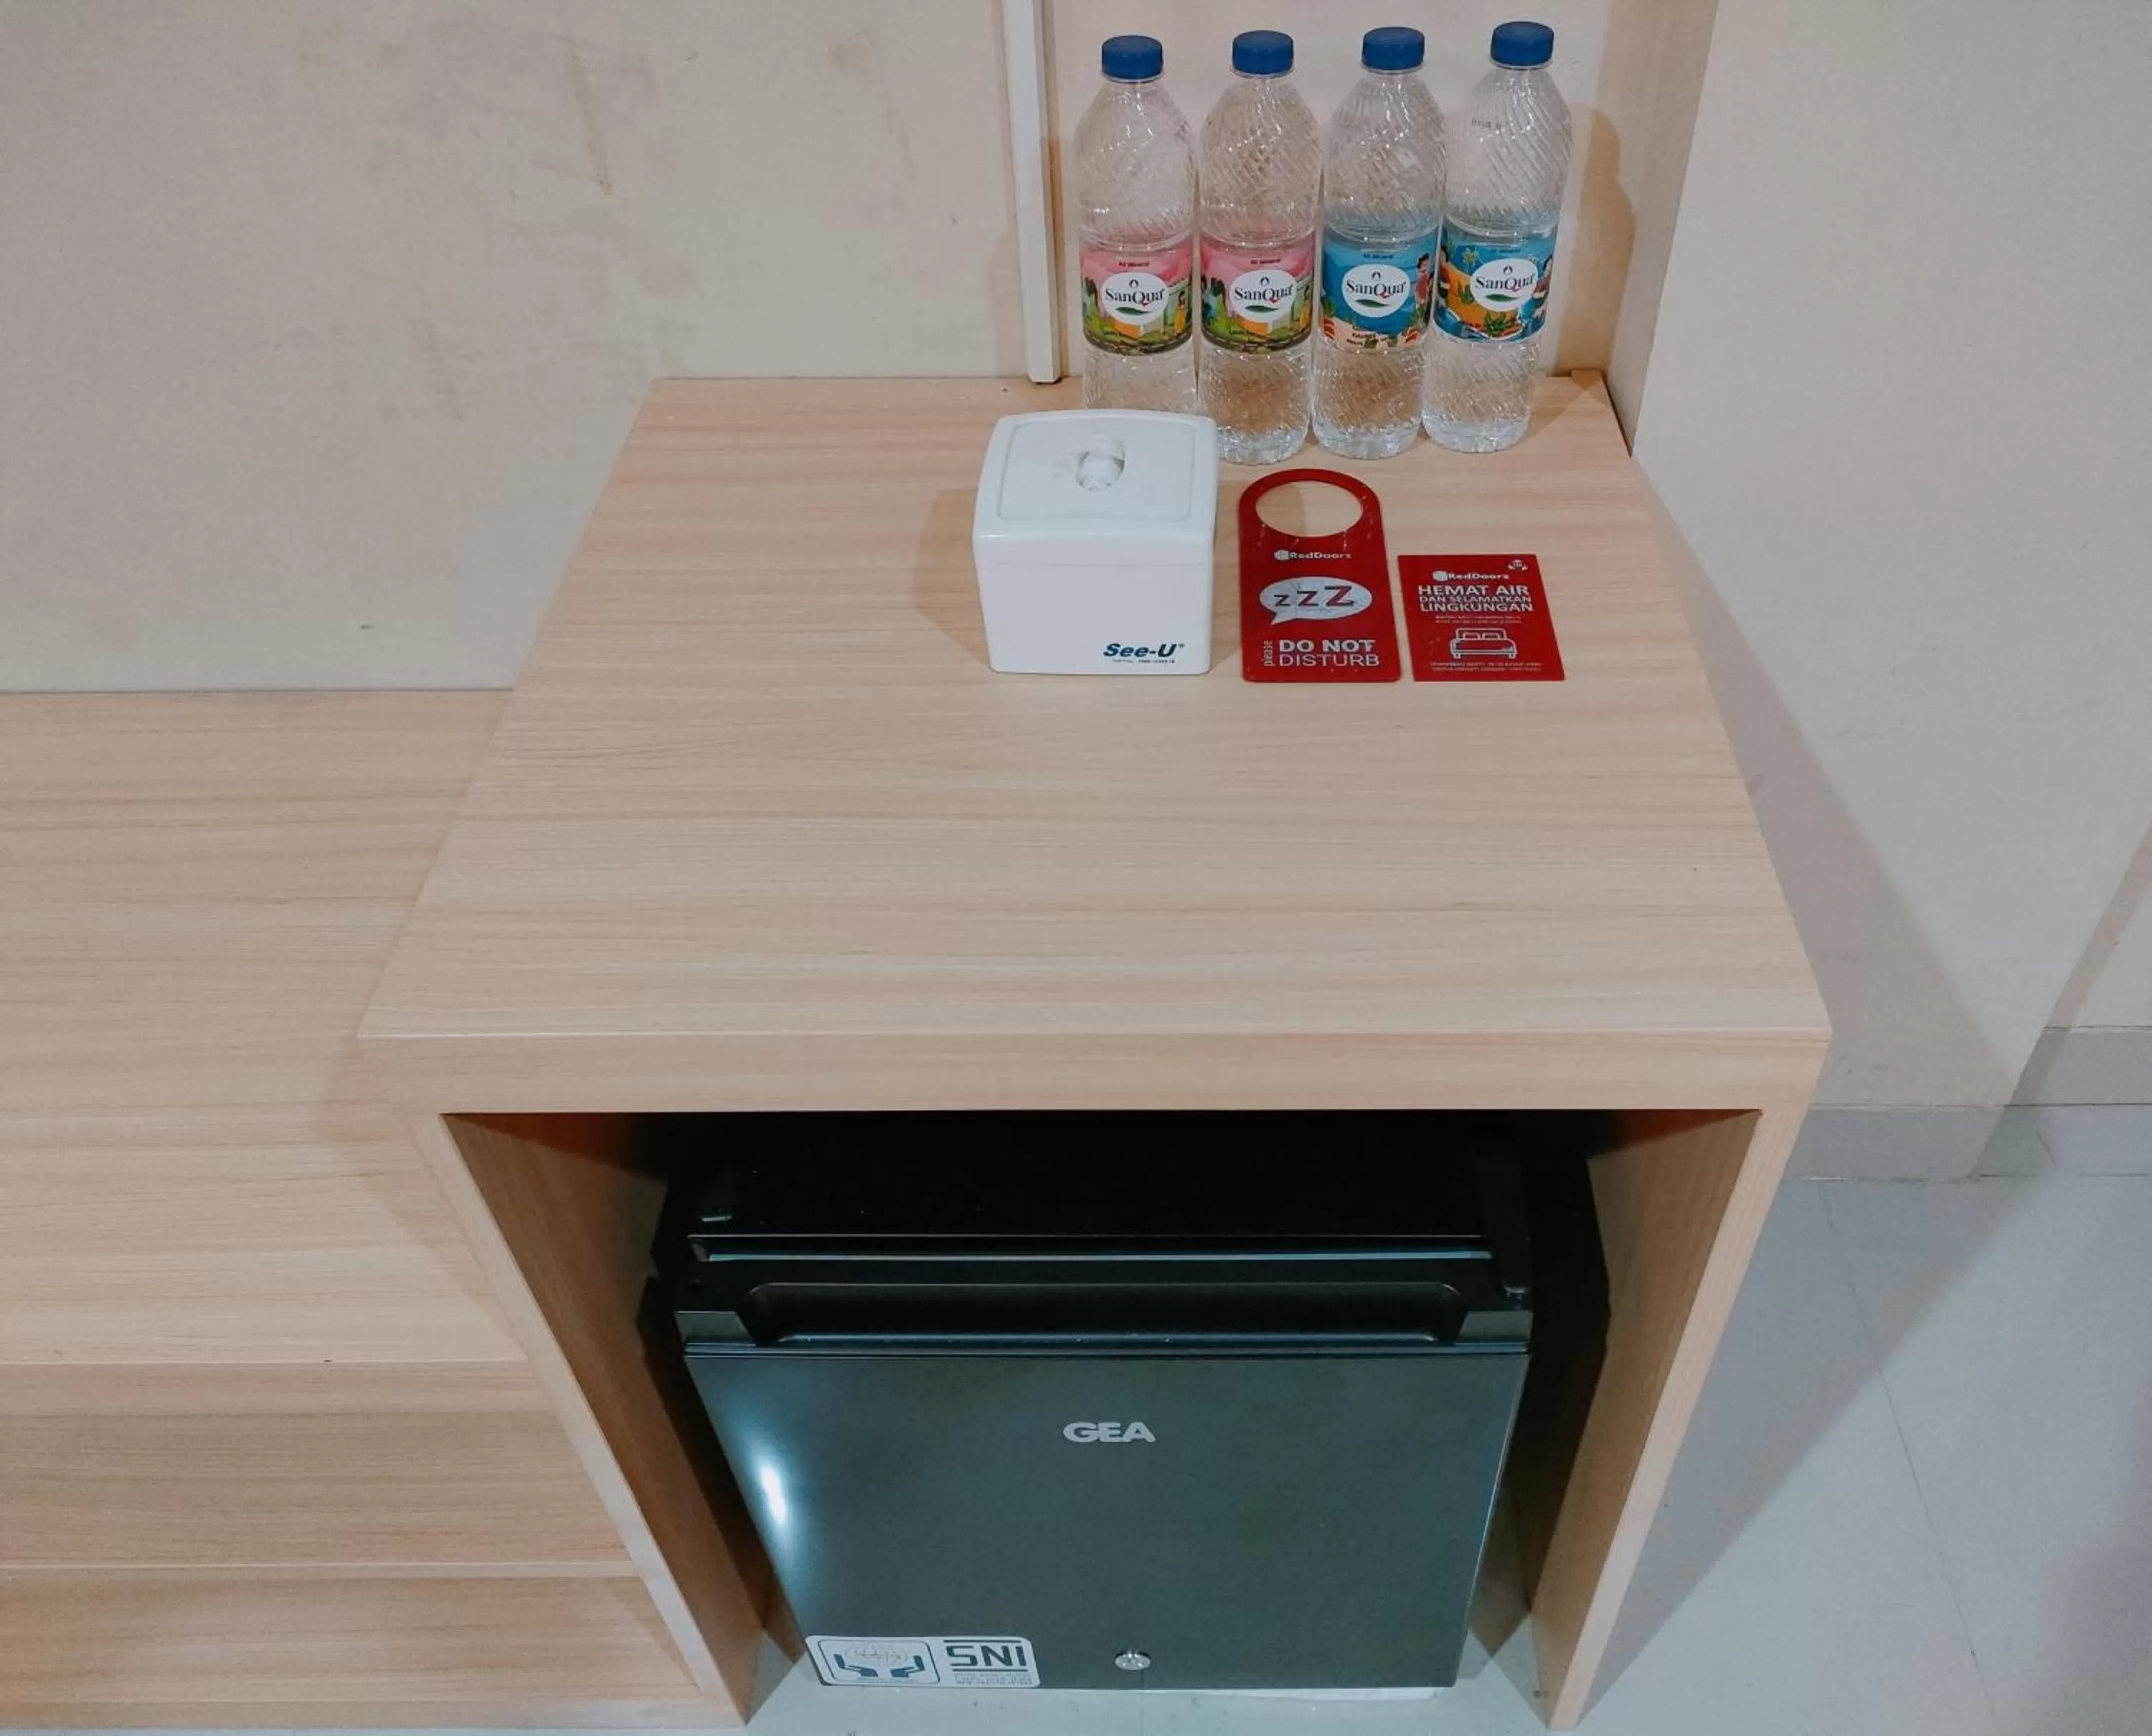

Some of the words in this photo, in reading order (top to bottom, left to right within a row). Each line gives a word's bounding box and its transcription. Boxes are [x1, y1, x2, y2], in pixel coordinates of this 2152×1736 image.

[1346, 280, 1405, 298] SanQua
[1475, 275, 1534, 292] SanQua
[1105, 288, 1164, 306] SanQua
[1235, 285, 1293, 303] SanQua
[1418, 585, 1488, 595] HEMAT
[1496, 585, 1529, 595] AIR
[1420, 603, 1534, 612] LINGKUNGAN
[1279, 639, 1315, 652] DO
[1322, 639, 1377, 652] NOT
[1279, 654, 1380, 666] DISTURB
[1062, 1421, 1156, 1443] GEA
[945, 1645, 1028, 1666] SNI
